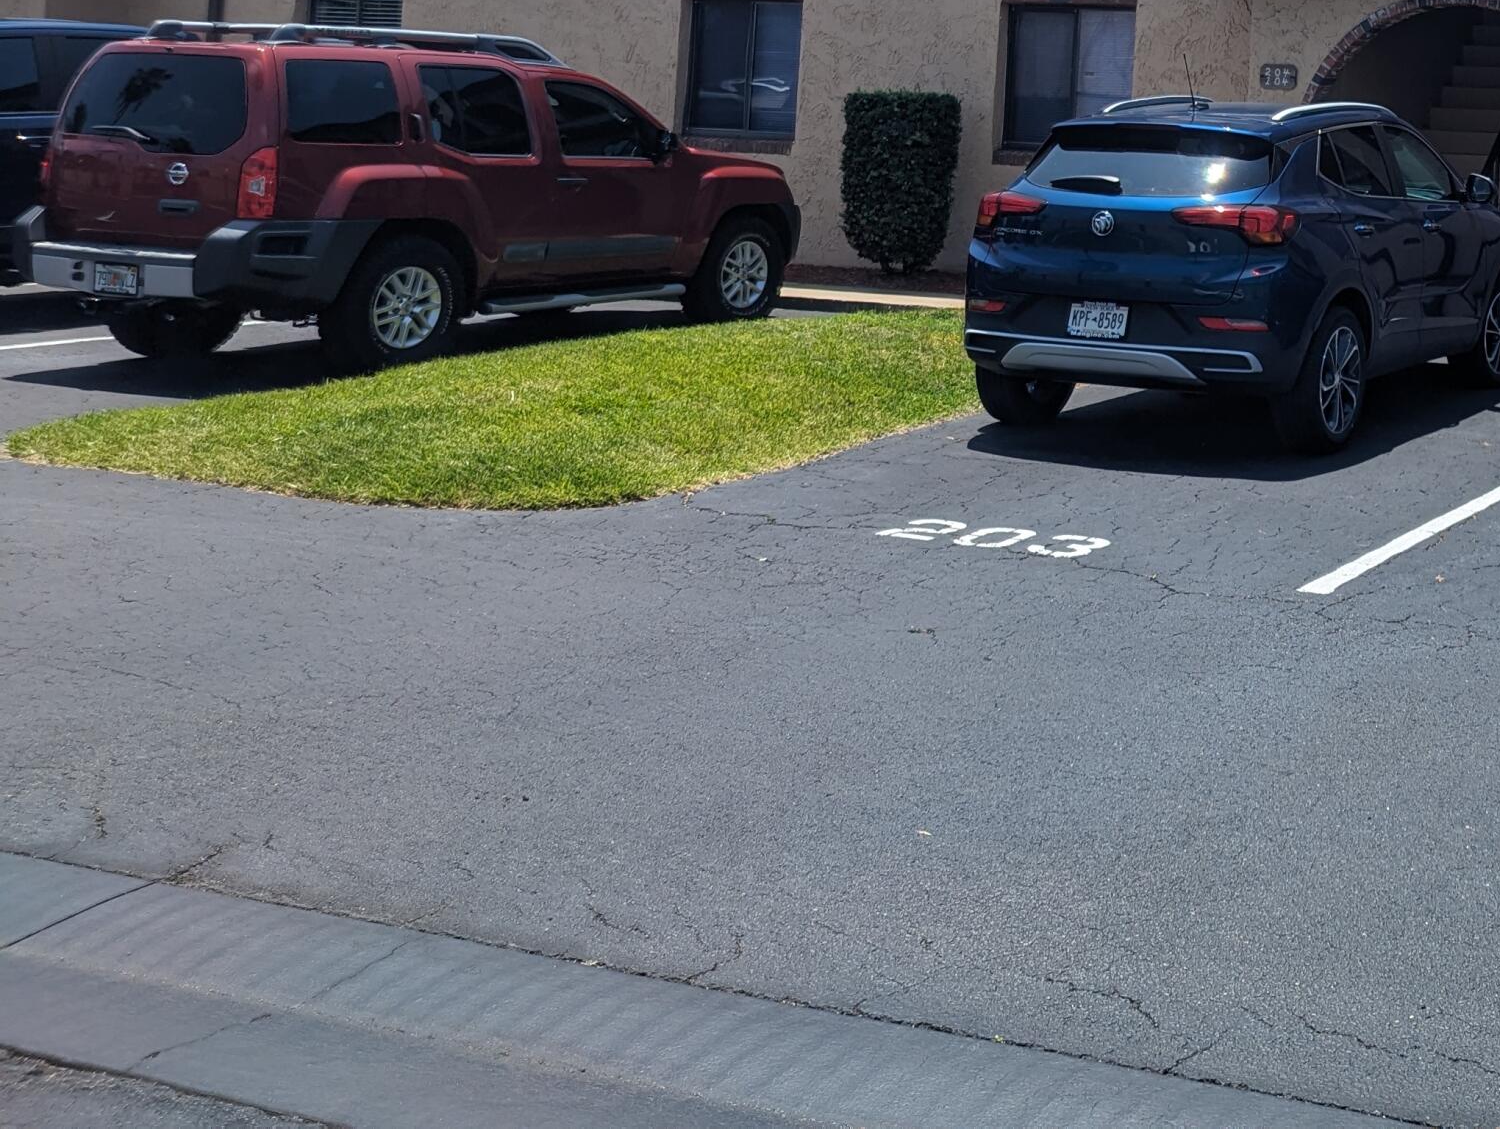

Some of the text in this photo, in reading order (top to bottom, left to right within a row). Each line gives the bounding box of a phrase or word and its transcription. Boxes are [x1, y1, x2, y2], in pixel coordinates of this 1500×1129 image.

[1264, 67, 1290, 77] 204
[1071, 309, 1124, 330] KPF 8589
[874, 519, 1111, 558] 203
